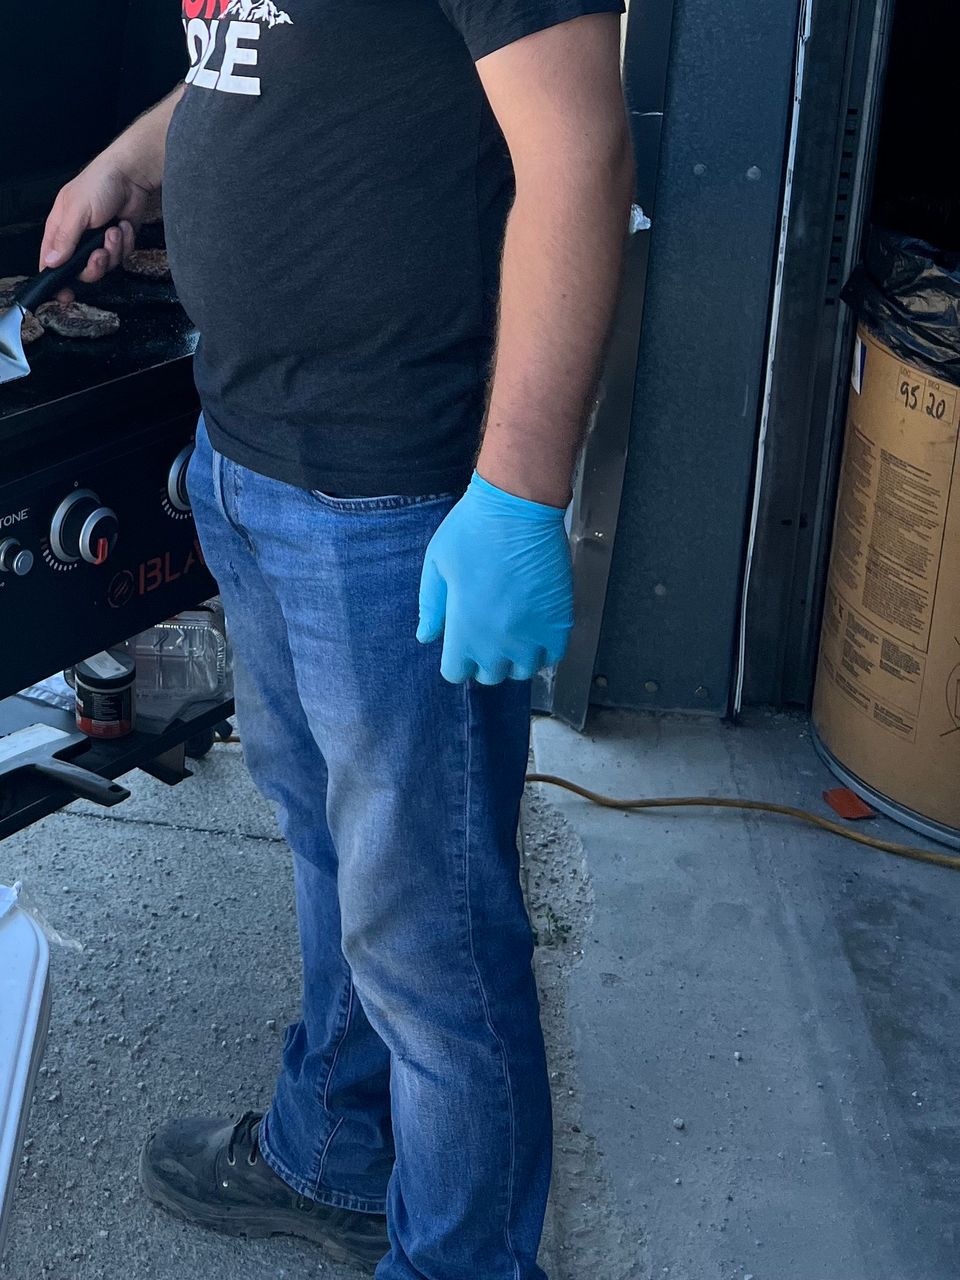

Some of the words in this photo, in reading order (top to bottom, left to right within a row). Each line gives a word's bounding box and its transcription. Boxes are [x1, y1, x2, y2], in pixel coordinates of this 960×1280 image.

[182, 18, 261, 95] OLE
[900, 381, 920, 410] 95
[926, 392, 946, 419] 20
